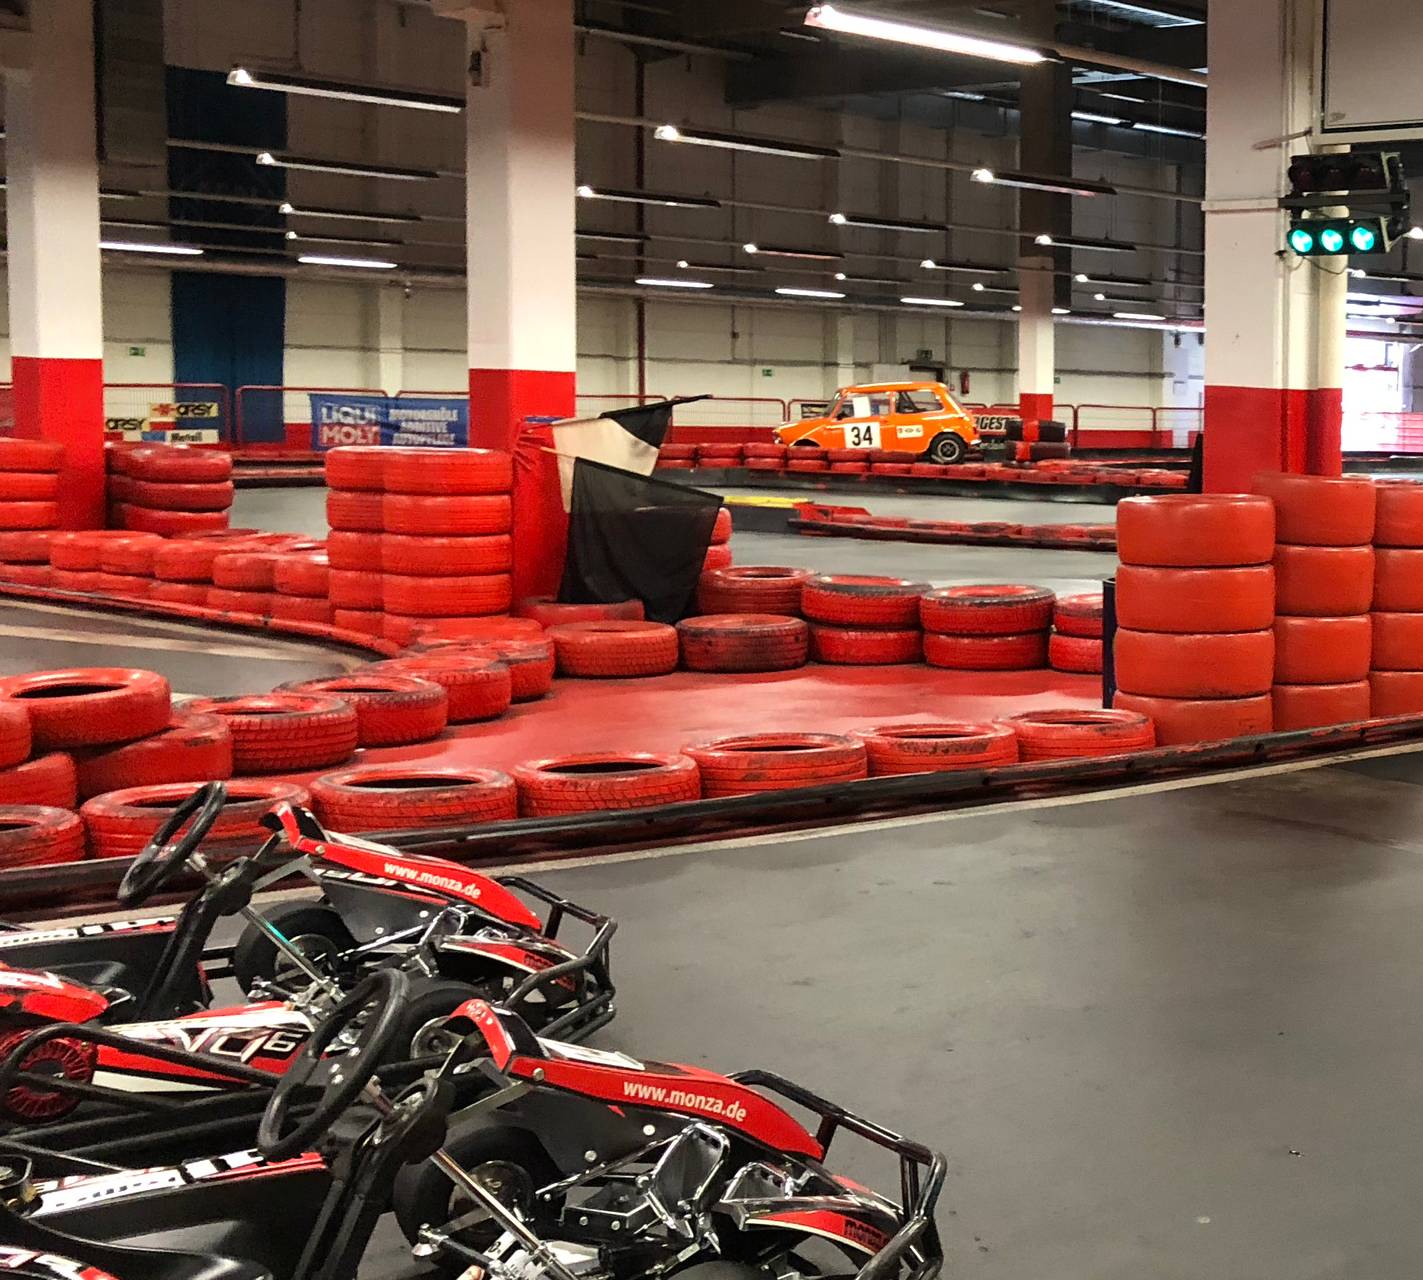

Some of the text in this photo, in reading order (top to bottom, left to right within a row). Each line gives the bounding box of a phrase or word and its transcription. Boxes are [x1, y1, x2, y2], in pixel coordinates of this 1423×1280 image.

[321, 425, 380, 444] MOLY
[850, 425, 873, 446] 34
[383, 862, 481, 899] www.monza.de
[623, 1081, 747, 1122] www.monza.de
